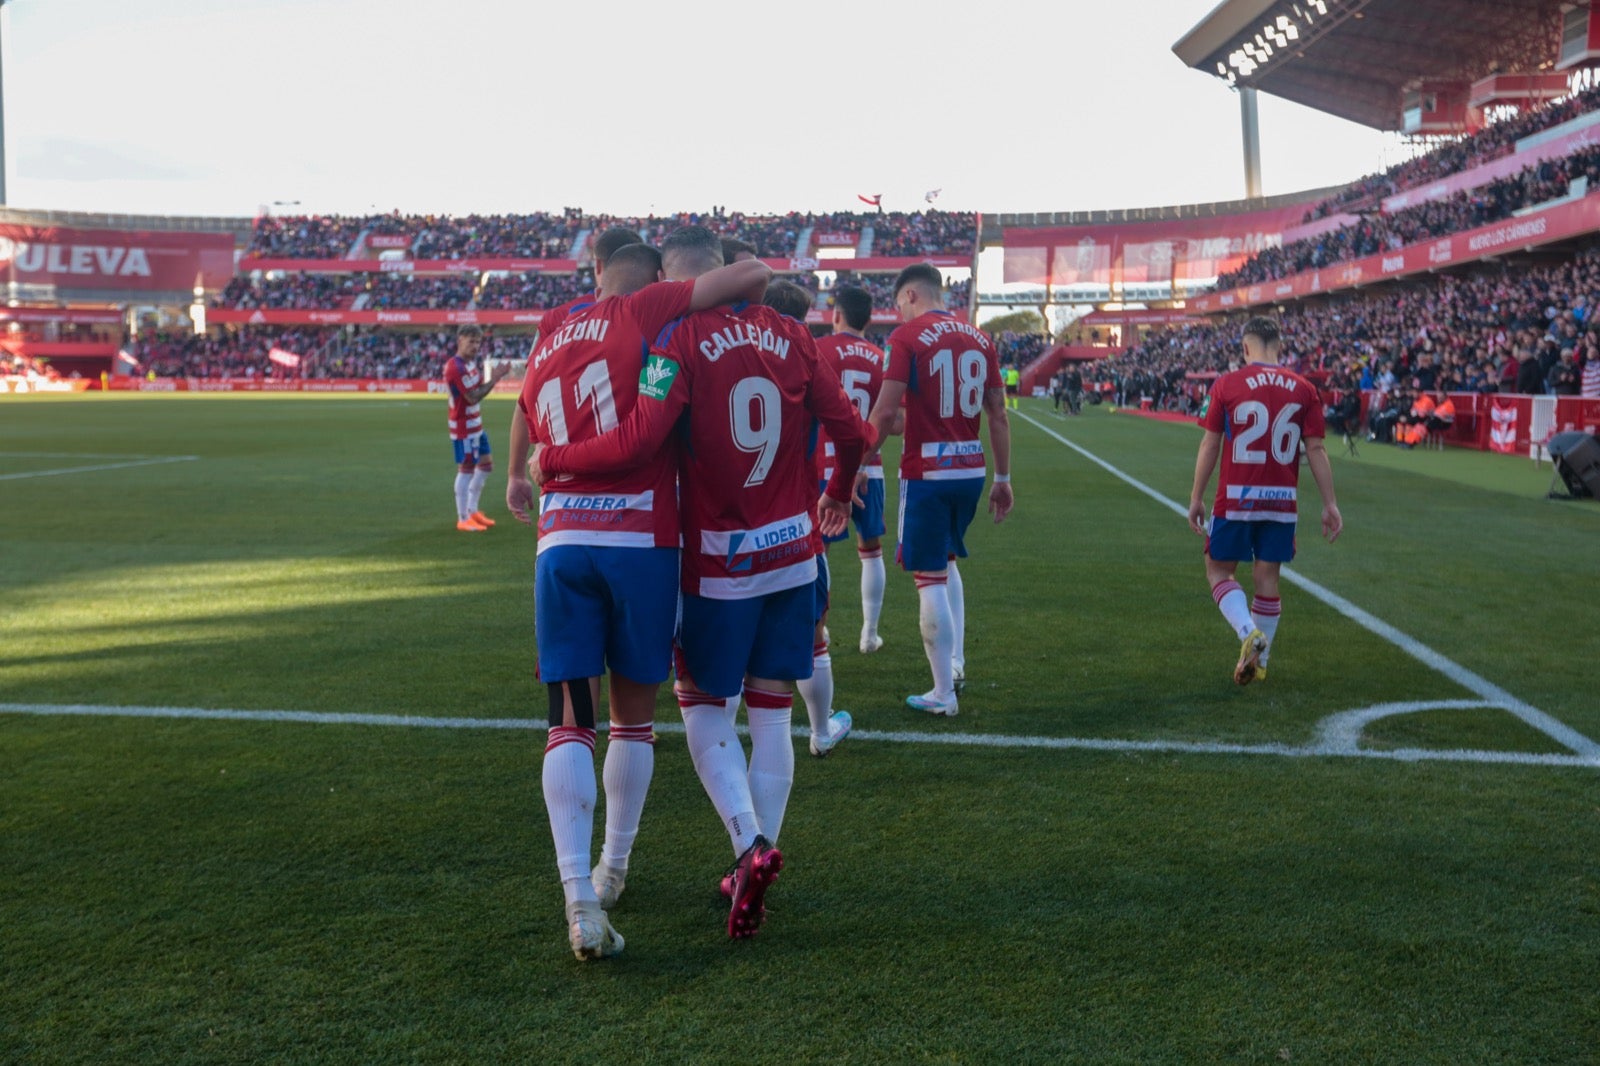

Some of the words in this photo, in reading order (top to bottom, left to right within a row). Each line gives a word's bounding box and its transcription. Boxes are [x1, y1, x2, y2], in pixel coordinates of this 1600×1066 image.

[699, 323, 790, 362] CALLEJÓN
[835, 345, 880, 366] J.SILVA
[841, 369, 872, 422] 5
[929, 348, 988, 419] 18
[1245, 371, 1297, 392] BRYAN
[535, 358, 619, 447] 11
[729, 375, 782, 488] 9
[1231, 400, 1303, 466] 26
[562, 496, 628, 511] LIDERA
[1257, 488, 1294, 500] LIDERA
[754, 523, 806, 550] LIDERA
